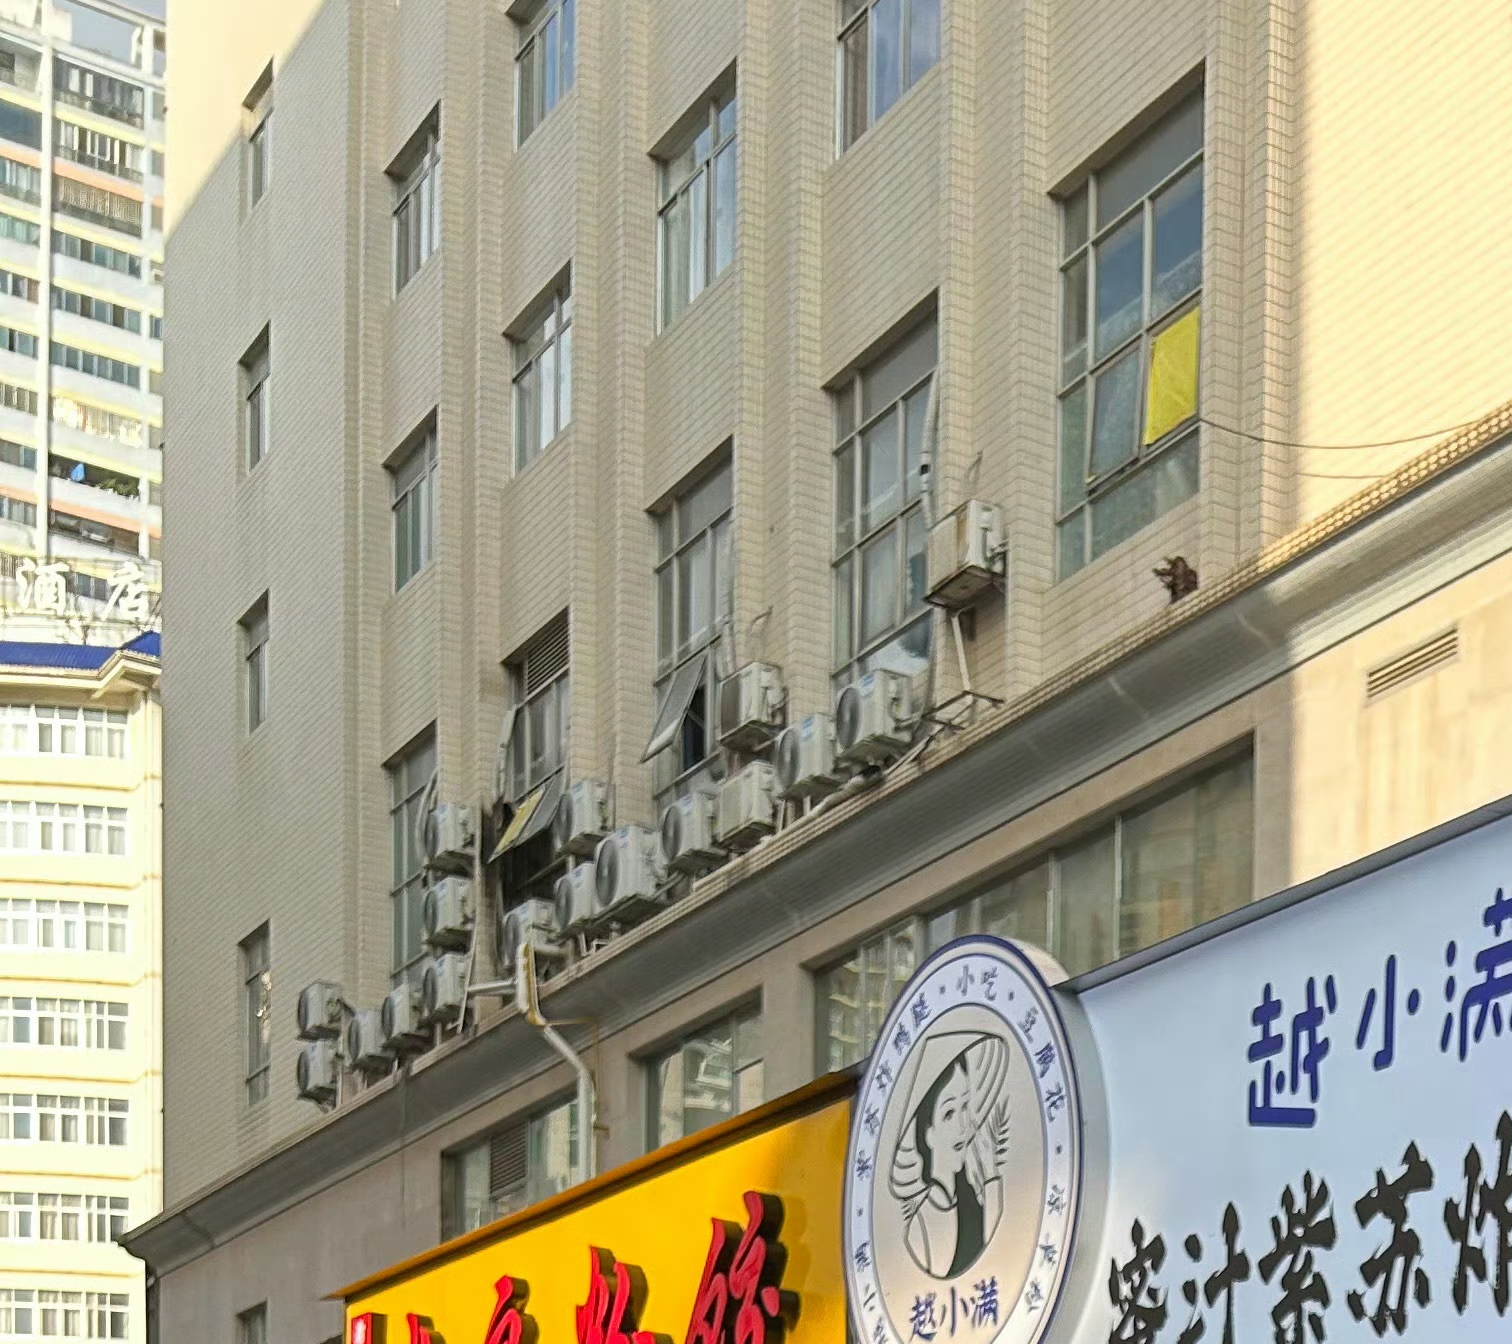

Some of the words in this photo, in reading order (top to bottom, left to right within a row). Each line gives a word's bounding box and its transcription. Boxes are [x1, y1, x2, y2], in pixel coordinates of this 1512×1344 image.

[15, 557, 149, 622] 酒店
[910, 1277, 998, 1343] 越小满
